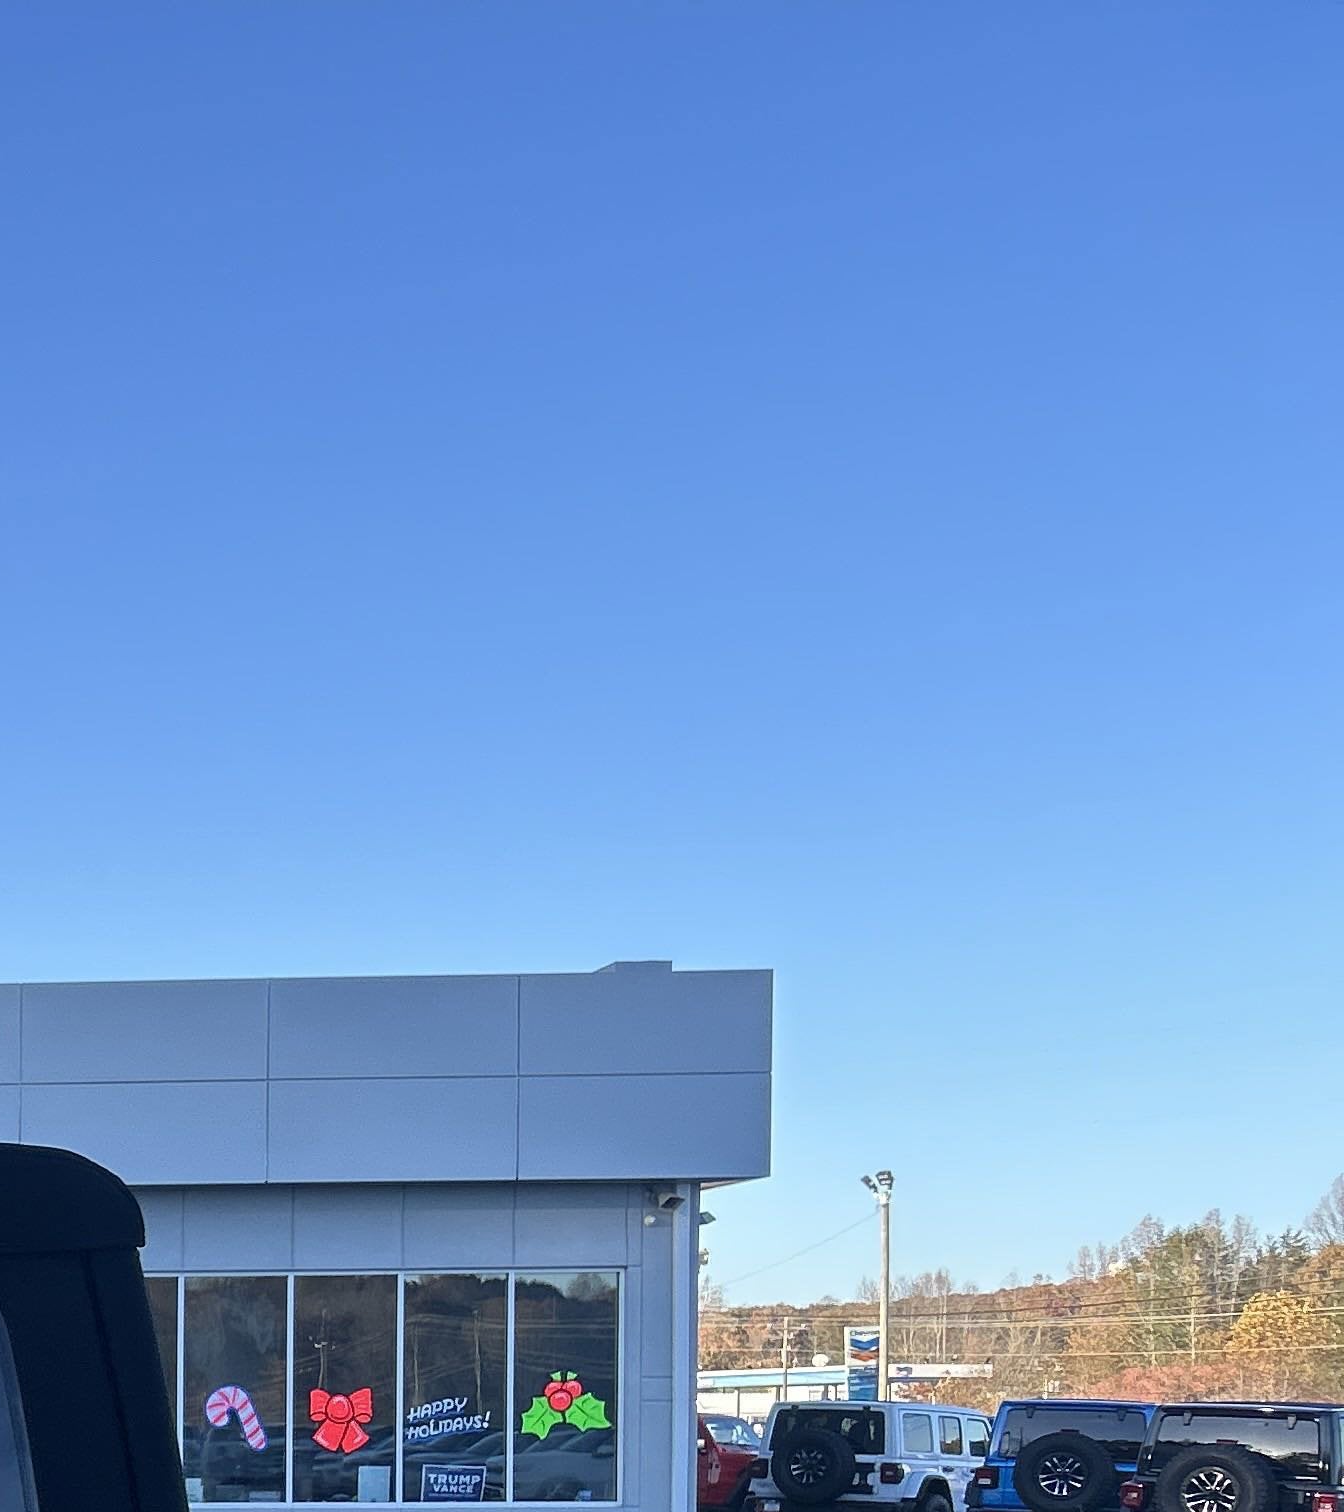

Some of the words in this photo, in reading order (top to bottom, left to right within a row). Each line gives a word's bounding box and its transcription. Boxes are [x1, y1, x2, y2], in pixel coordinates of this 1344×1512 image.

[407, 1397, 468, 1421] HAPPY
[406, 1411, 491, 1440] HOLIDAYS!
[427, 1473, 481, 1485] TRUMP
[432, 1484, 473, 1493] VANCE
